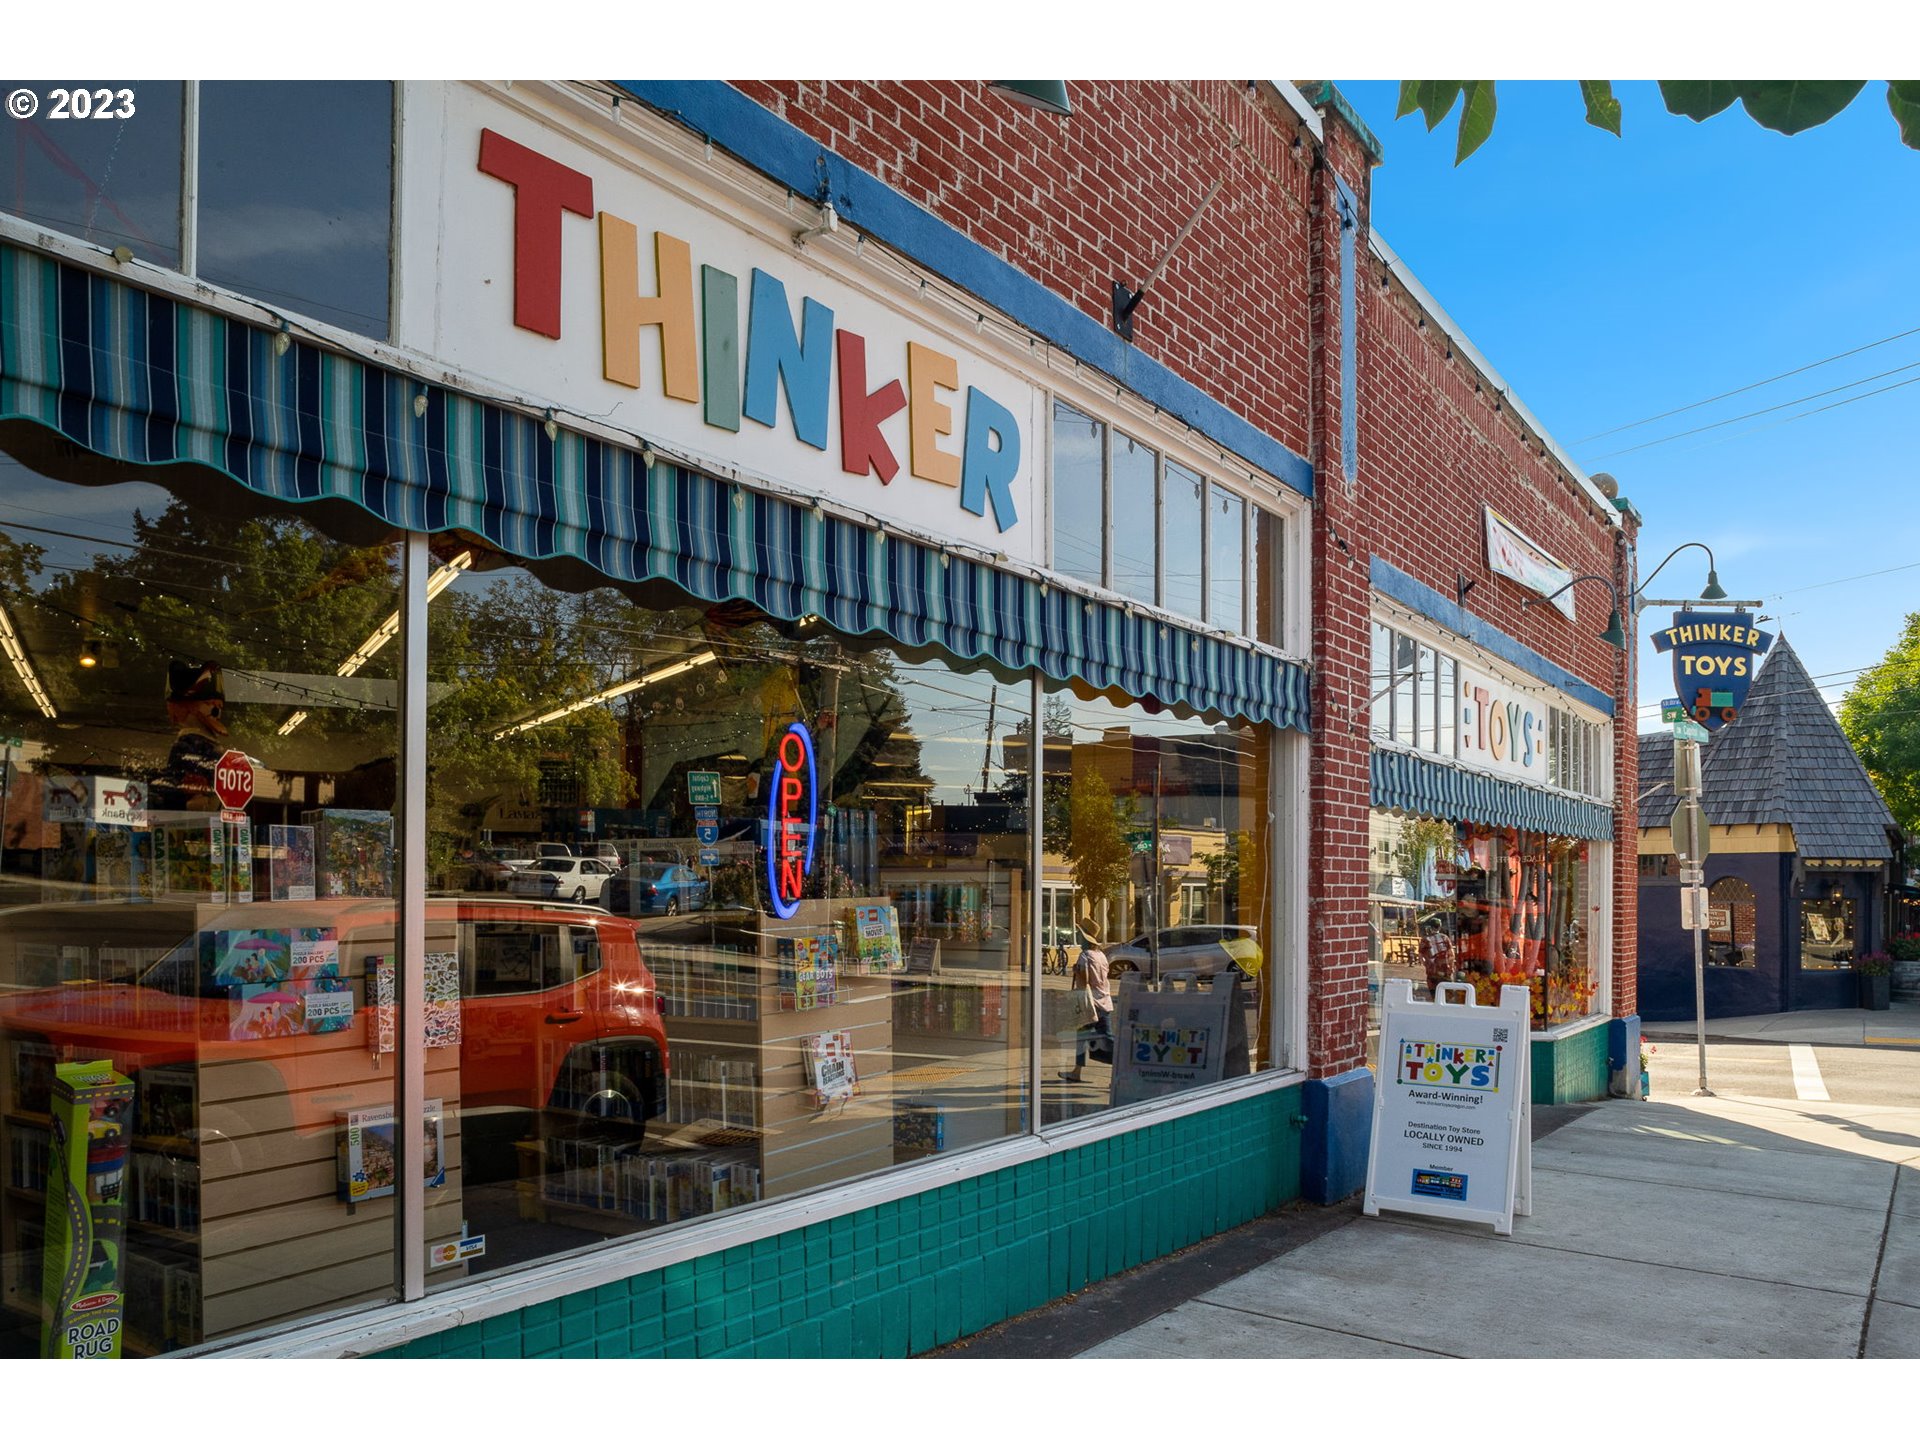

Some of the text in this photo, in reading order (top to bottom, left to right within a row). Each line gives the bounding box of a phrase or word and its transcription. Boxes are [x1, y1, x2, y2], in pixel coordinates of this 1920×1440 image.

[1665, 623, 1760, 647] THINKER
[1680, 655, 1747, 677] TOYS
[1474, 686, 1535, 768] TOYS
[779, 733, 805, 898] OPEN
[292, 956, 308, 965] 200
[309, 955, 325, 964] PCS
[815, 969, 833, 980] BOTS
[307, 1008, 323, 1017] 200
[324, 1006, 340, 1016] PCS
[821, 1060, 844, 1077] CHAIN
[1405, 1061, 1490, 1087] TOYS
[1408, 1089, 1484, 1105] Award-Winning!
[350, 1127, 360, 1146] 500
[1408, 1120, 1481, 1135] Destination Toy Store
[1403, 1129, 1485, 1146] LOCALLY OWNED
[1422, 1142, 1443, 1151] SINCE
[68, 1317, 120, 1344] ROAD
[74, 1337, 113, 1359] RUG
